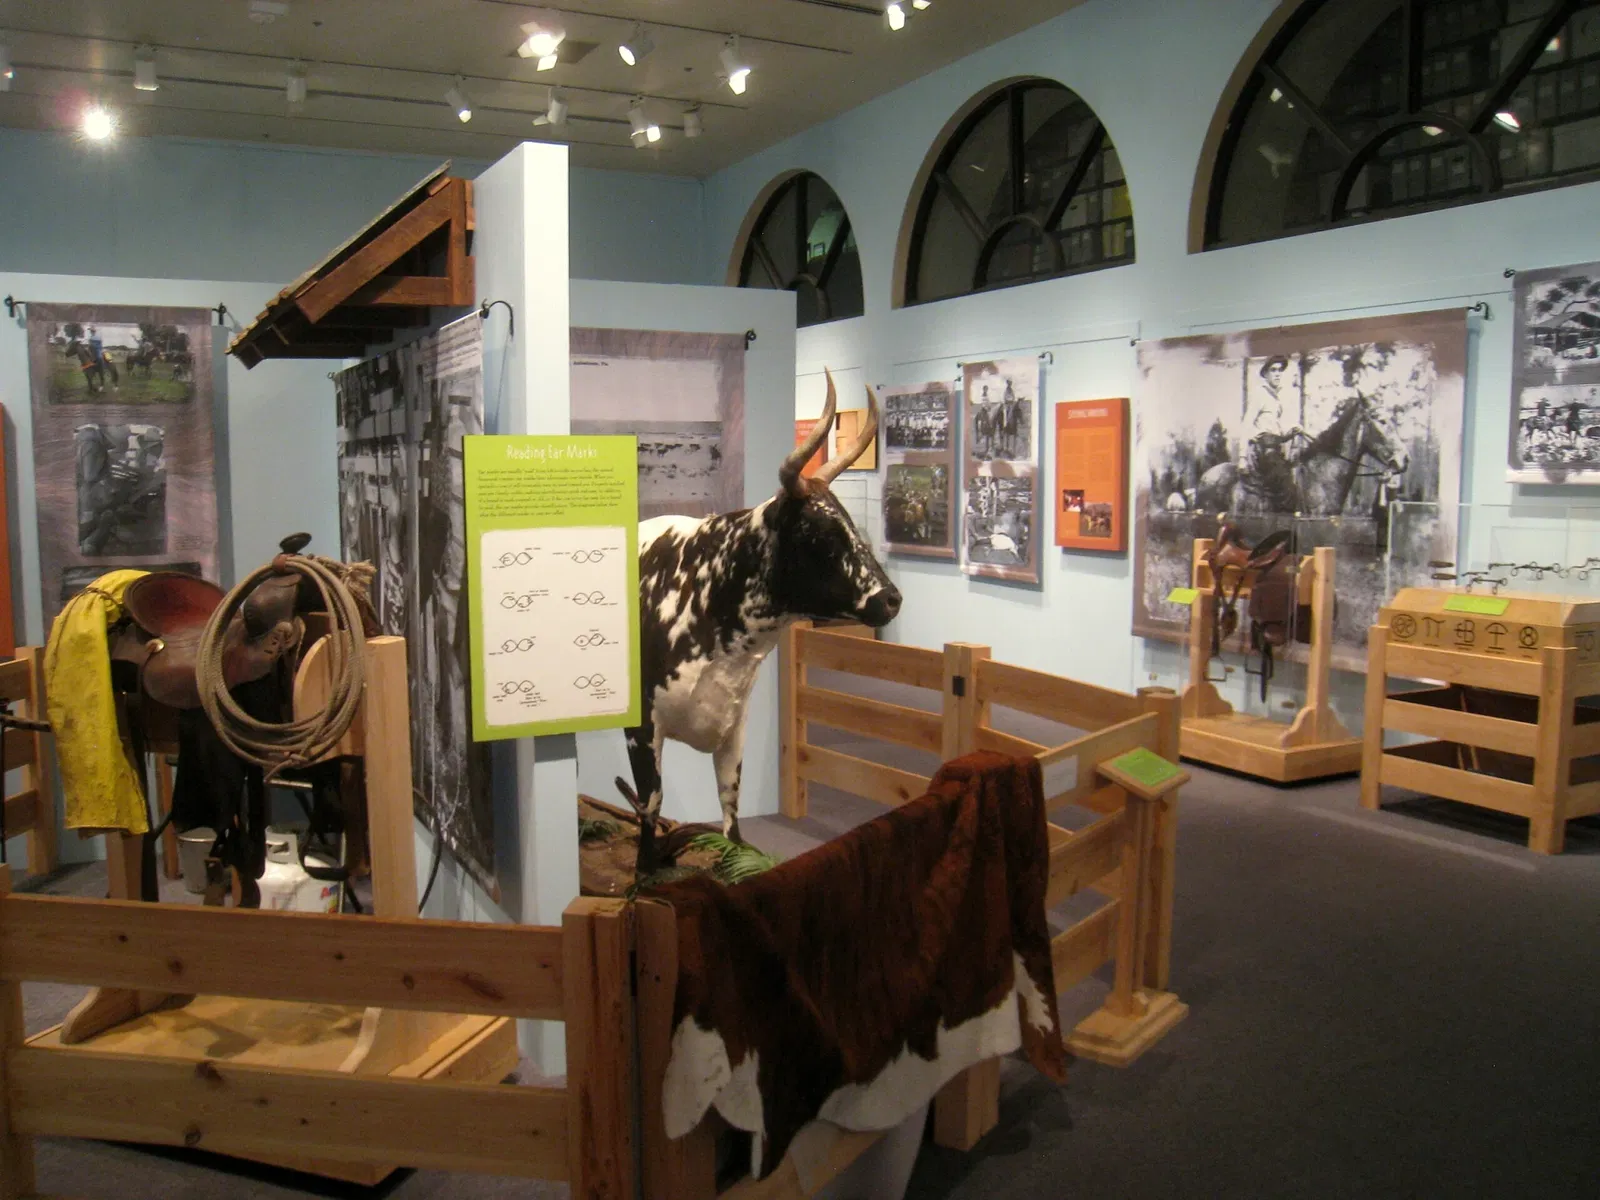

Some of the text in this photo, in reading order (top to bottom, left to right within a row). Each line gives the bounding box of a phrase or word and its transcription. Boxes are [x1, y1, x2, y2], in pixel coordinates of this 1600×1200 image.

[506, 444, 597, 464] Reading Ear Marks
